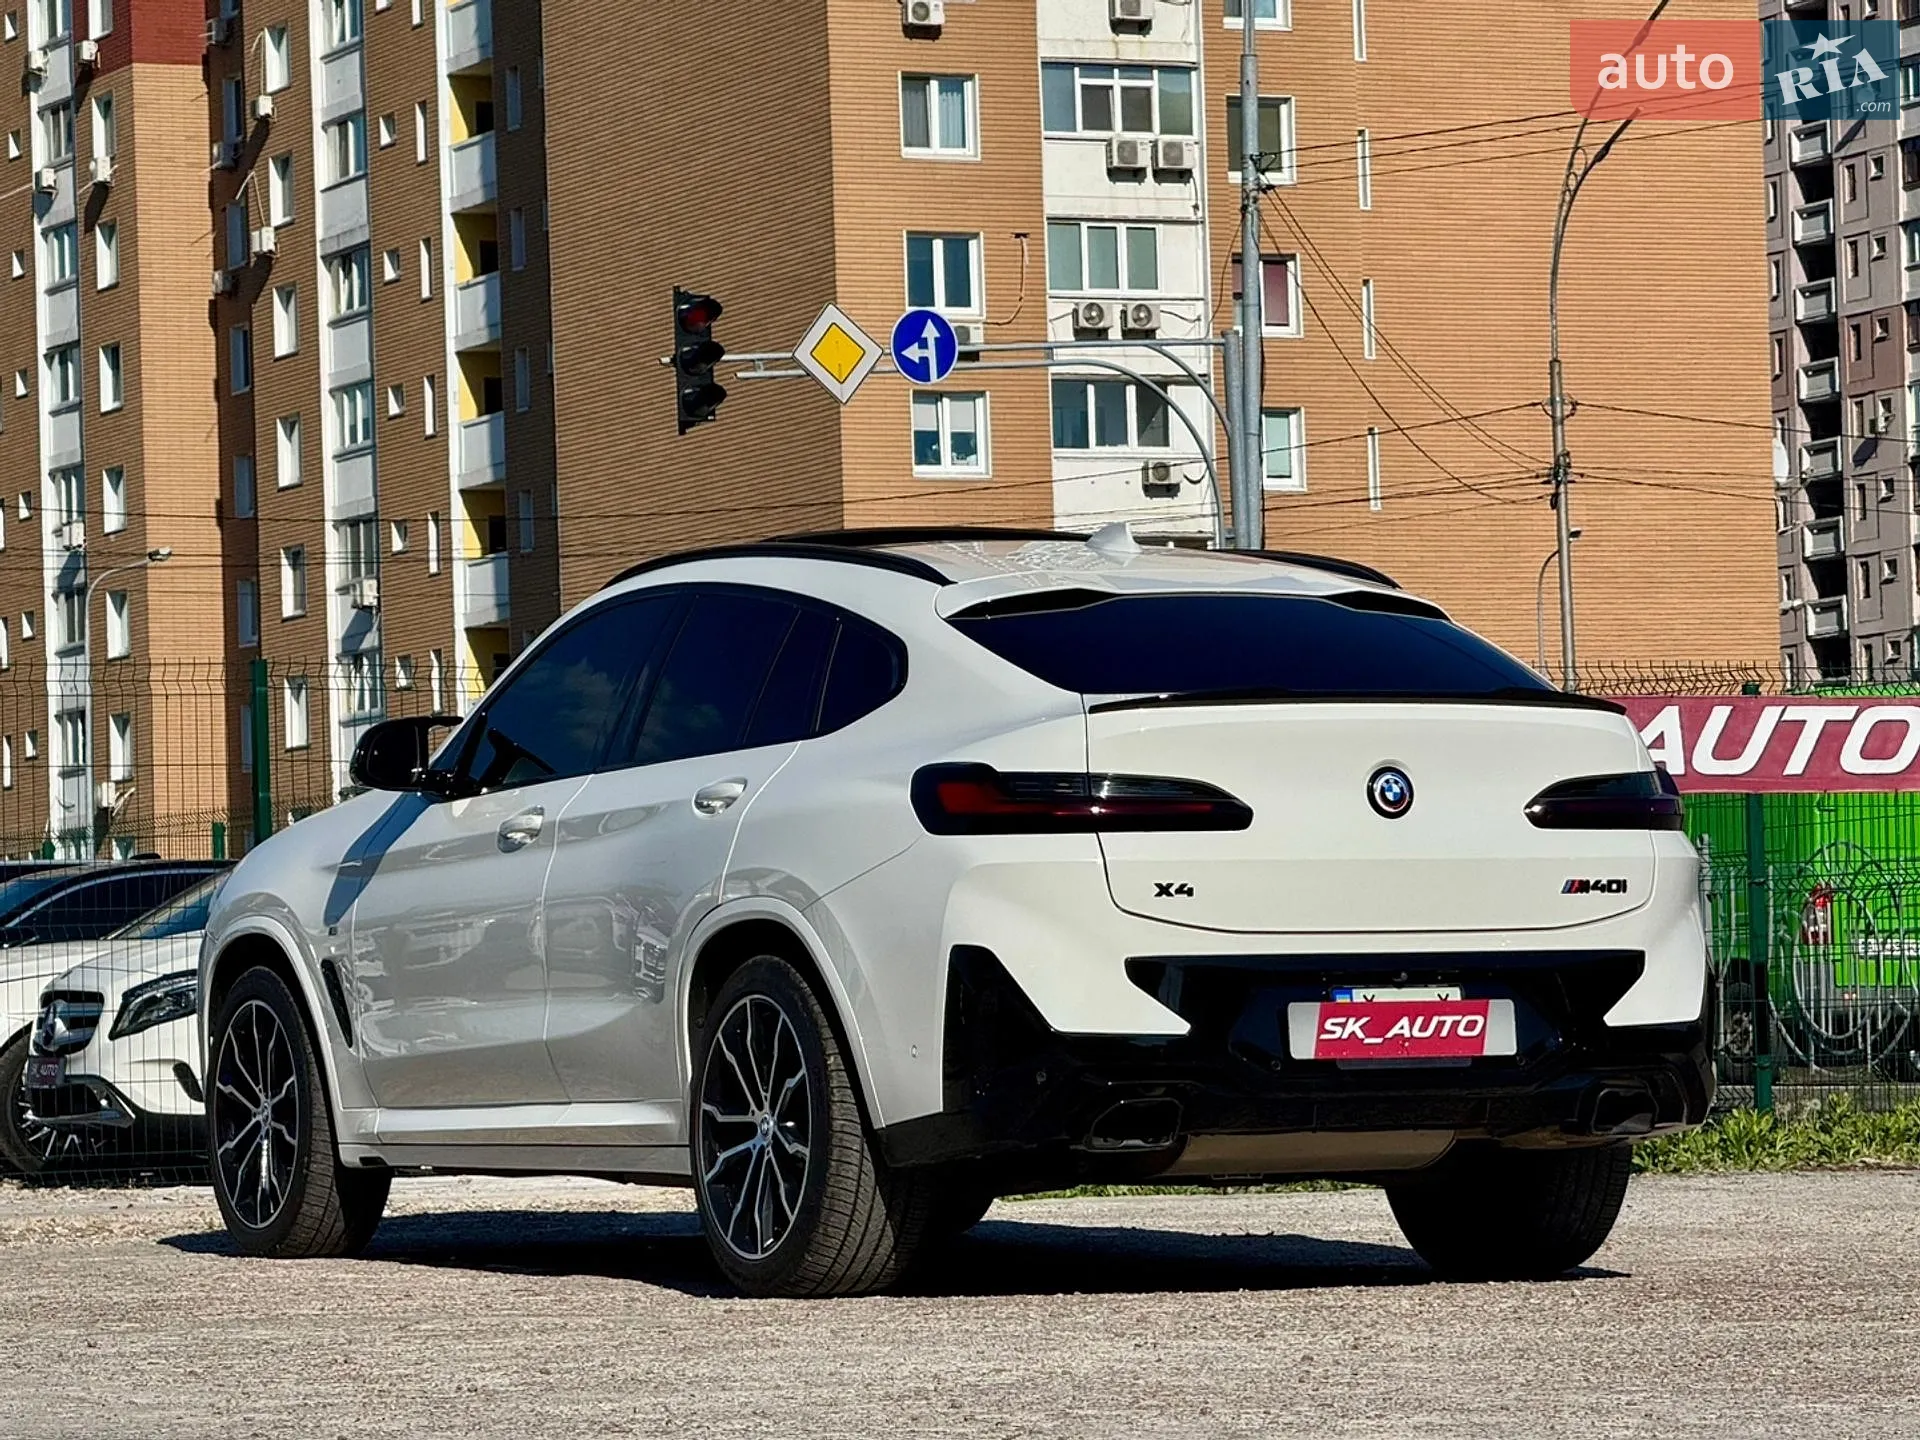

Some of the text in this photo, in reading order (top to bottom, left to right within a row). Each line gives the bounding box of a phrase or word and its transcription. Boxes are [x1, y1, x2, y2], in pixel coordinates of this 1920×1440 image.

[1639, 705, 1920, 775] AUTO
[1153, 882, 1194, 897] X4
[1319, 1015, 1486, 1044] SK_AUTO
